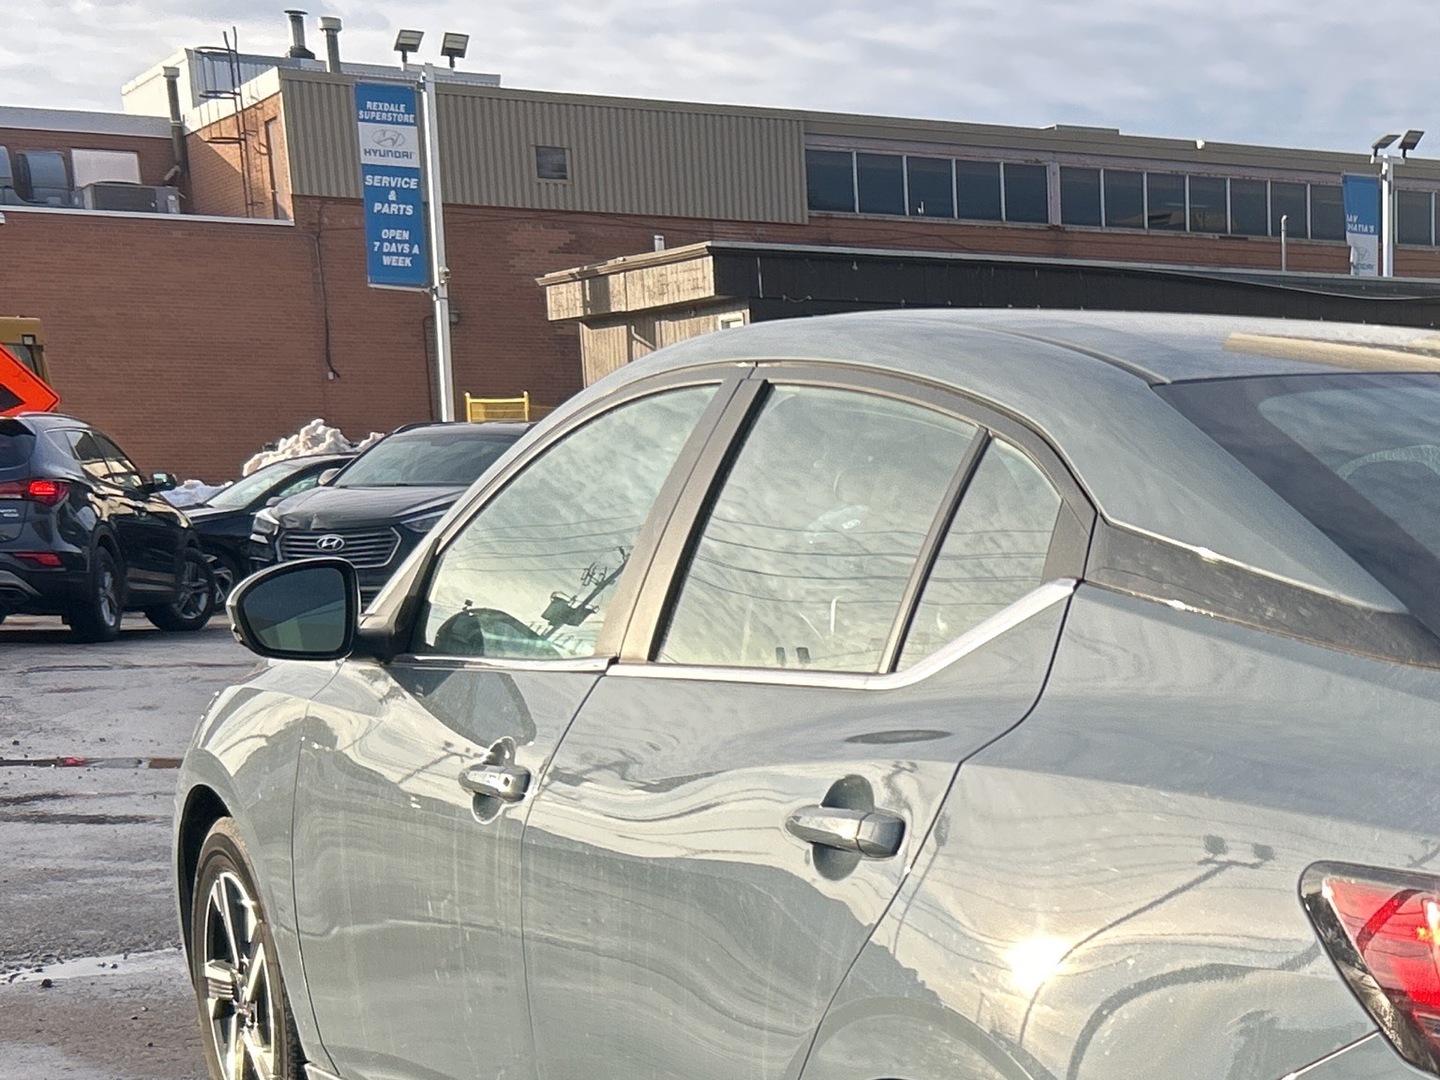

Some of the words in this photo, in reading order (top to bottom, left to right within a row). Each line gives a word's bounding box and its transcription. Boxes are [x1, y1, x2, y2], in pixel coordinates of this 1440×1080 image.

[366, 101, 406, 113] REXDALE
[358, 110, 415, 123] SUPERSTORE
[363, 148, 413, 160] HYUNDAI
[365, 174, 418, 189] SERVICE
[388, 190, 397, 201] &
[373, 202, 414, 216] PARTS
[381, 229, 410, 241] OPEN
[373, 241, 380, 252] 7
[383, 242, 410, 254] DAYS
[412, 244, 420, 254] A
[382, 255, 412, 267] WEEK
